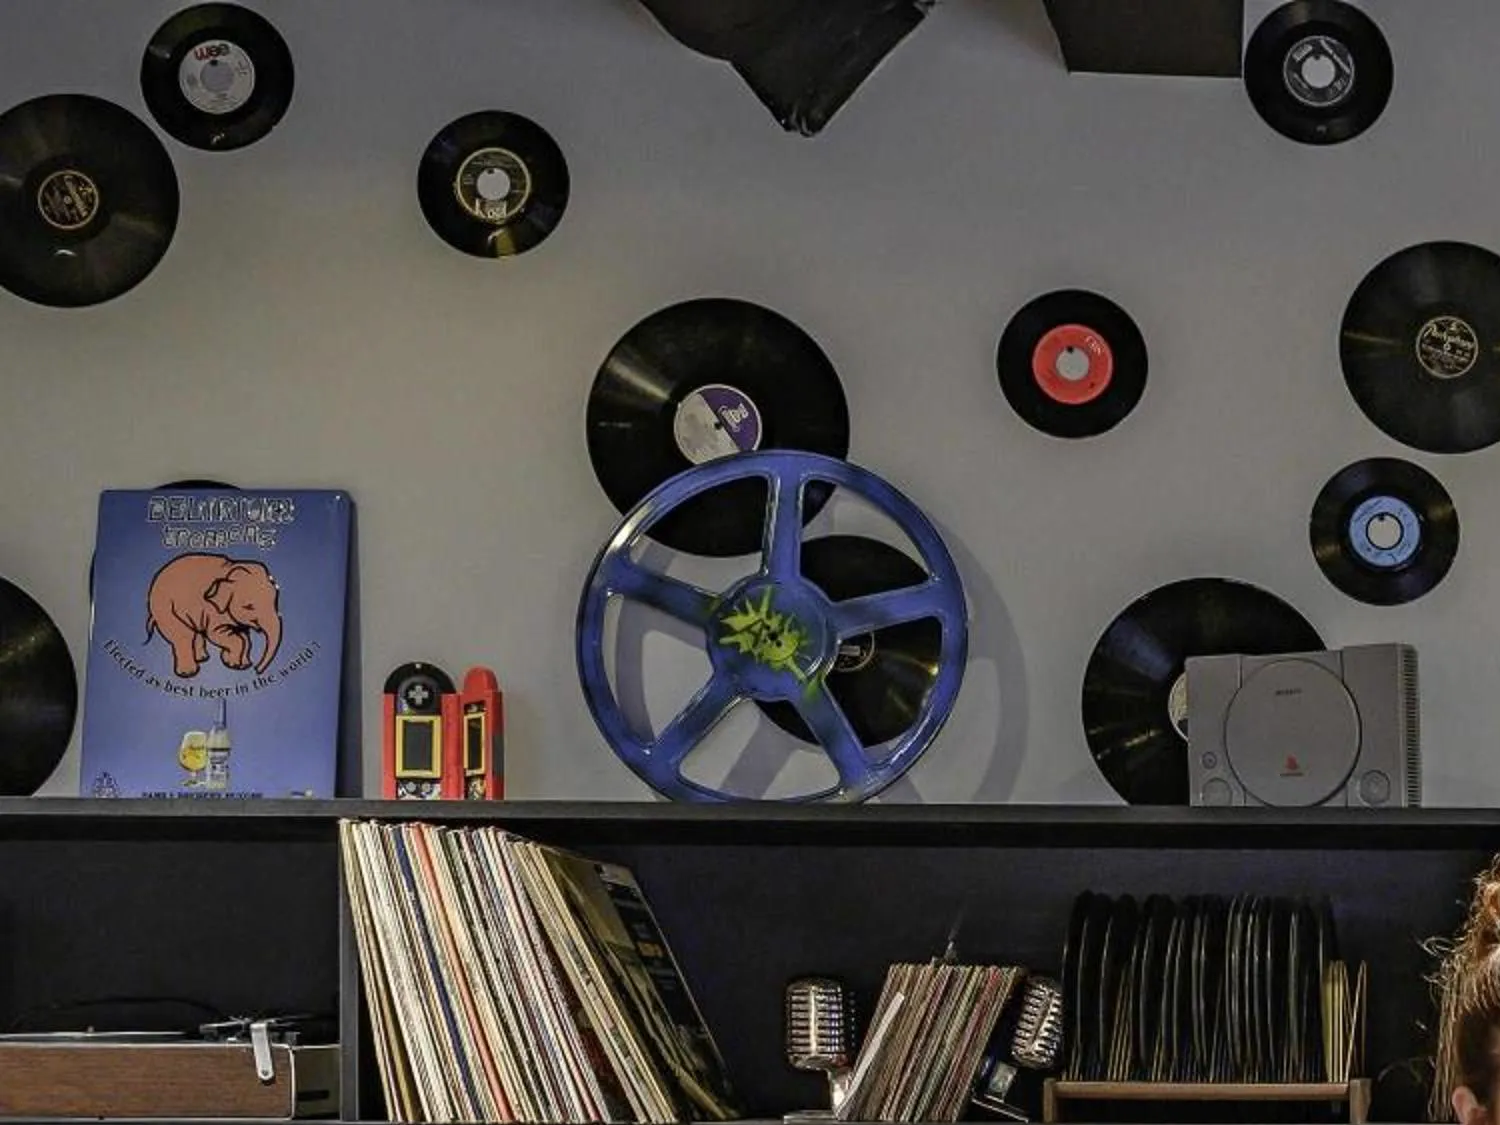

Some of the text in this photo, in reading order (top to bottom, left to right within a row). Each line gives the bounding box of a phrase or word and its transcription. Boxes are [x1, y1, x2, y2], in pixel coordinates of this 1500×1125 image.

[104, 639, 147, 678] Elected
[146, 677, 161, 689] as
[164, 682, 194, 697] best
[199, 686, 232, 698] beer
[236, 683, 250, 696] in
[252, 676, 277, 691] the
